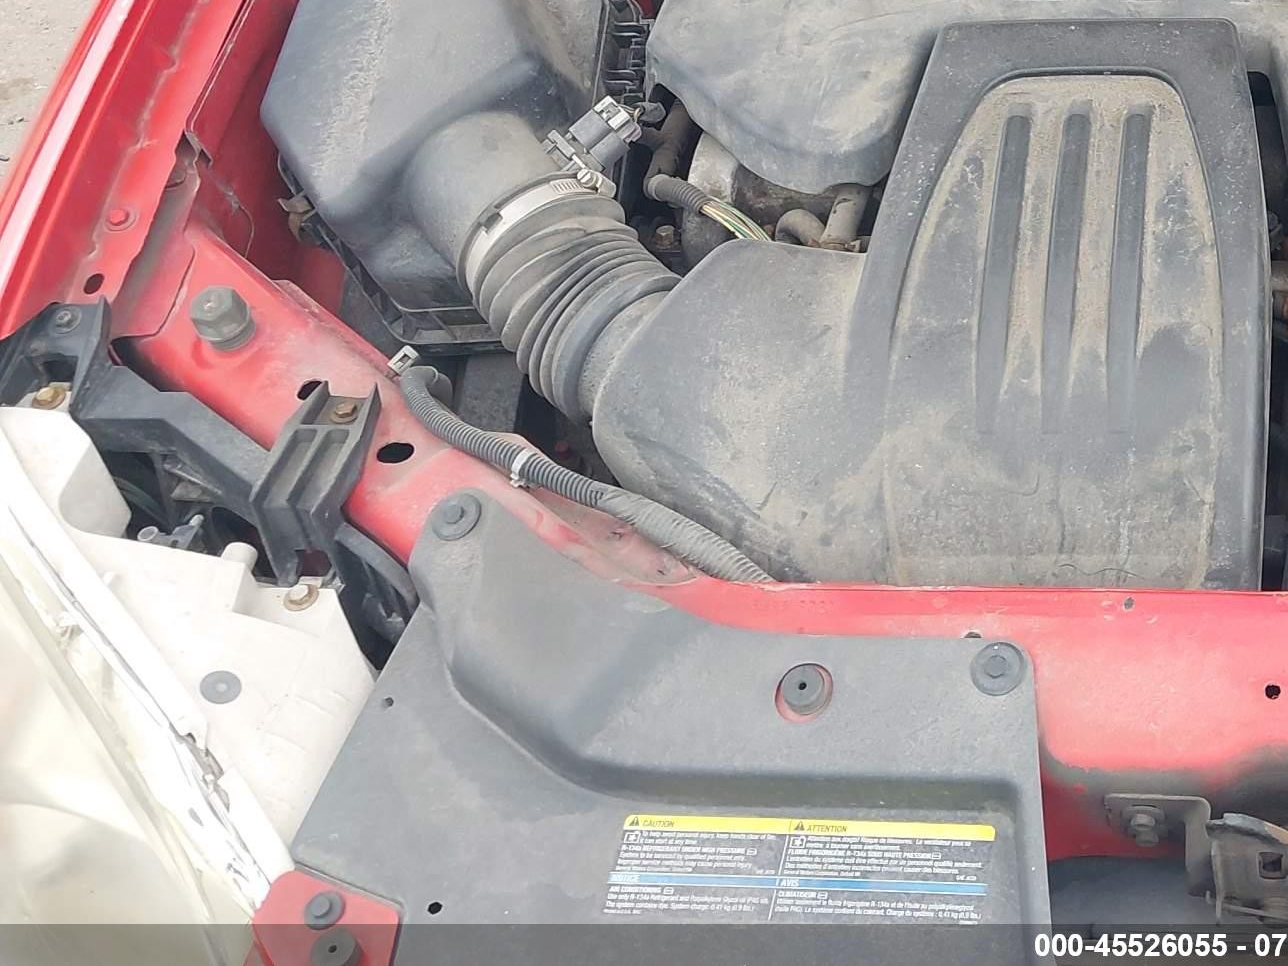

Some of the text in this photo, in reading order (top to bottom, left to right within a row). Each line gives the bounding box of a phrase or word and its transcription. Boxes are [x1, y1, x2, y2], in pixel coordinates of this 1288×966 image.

[641, 819, 675, 827] CAUTION
[805, 824, 847, 833] ATTENTION
[611, 874, 640, 883] NOTICE
[780, 878, 800, 887] AVIS
[777, 890, 817, 898] CLIMATISEUR
